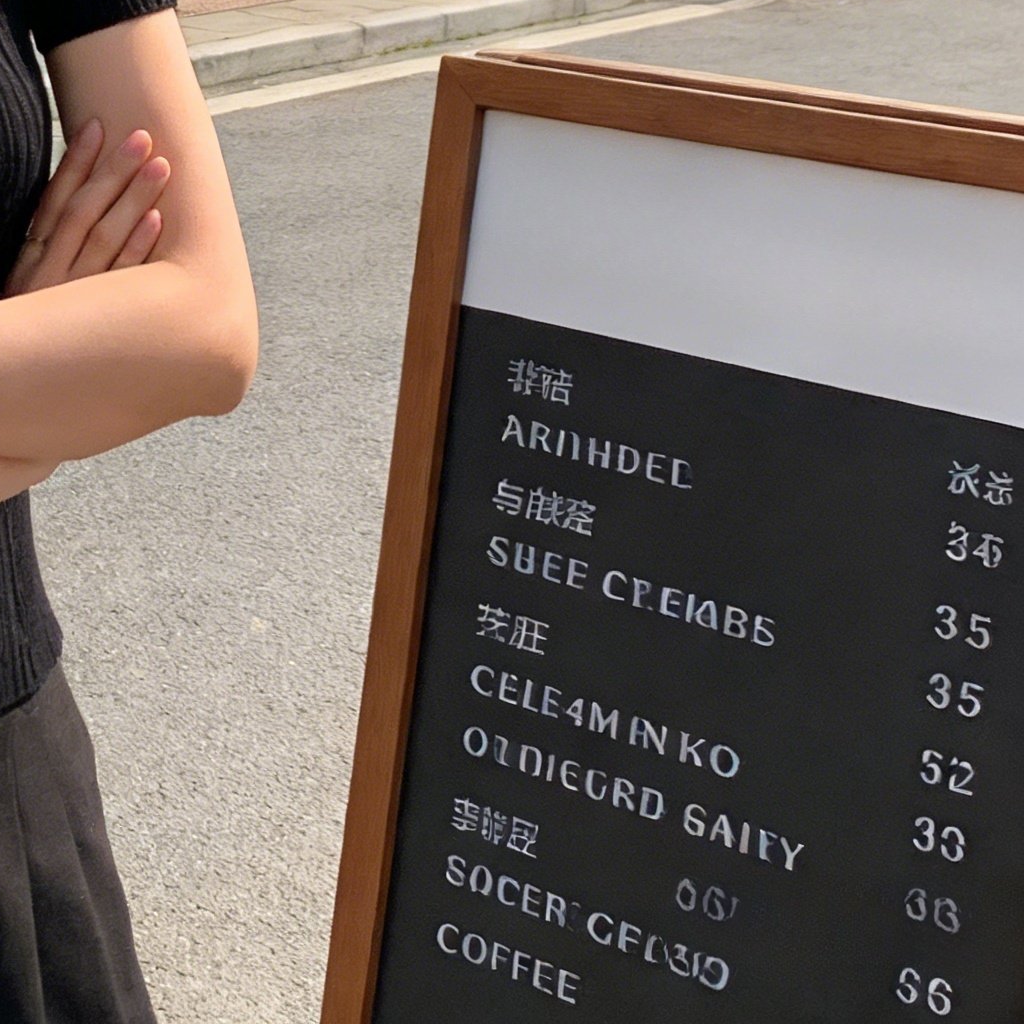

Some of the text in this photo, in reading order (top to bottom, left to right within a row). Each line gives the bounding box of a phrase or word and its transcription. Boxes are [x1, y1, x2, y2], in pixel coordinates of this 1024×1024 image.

[934, 605, 992, 650] 35
[926, 673, 985, 717] 35
[437, 923, 581, 1005] COFFEE
